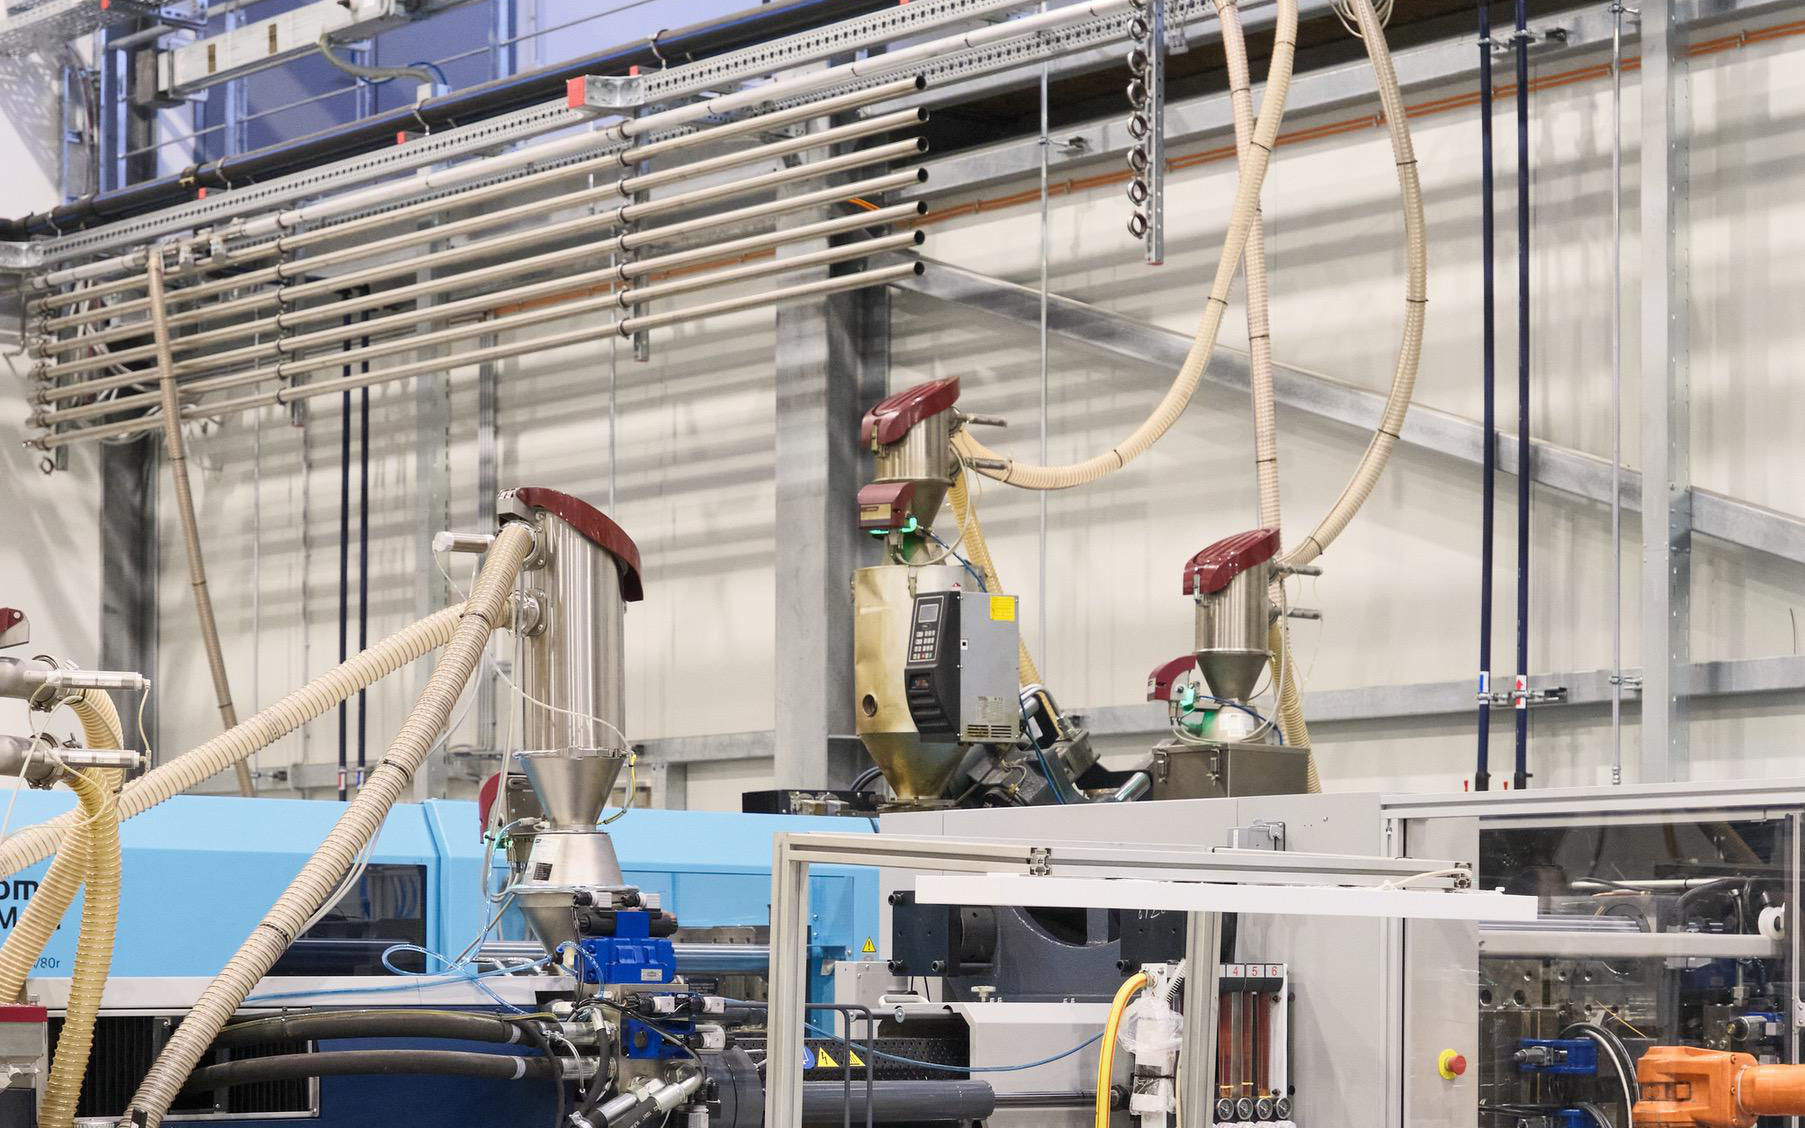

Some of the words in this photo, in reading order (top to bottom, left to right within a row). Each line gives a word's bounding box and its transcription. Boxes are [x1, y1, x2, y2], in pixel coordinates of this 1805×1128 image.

[1233, 966, 1239, 977] 4
[1252, 966, 1258, 977] 5
[1271, 966, 1278, 977] 6
